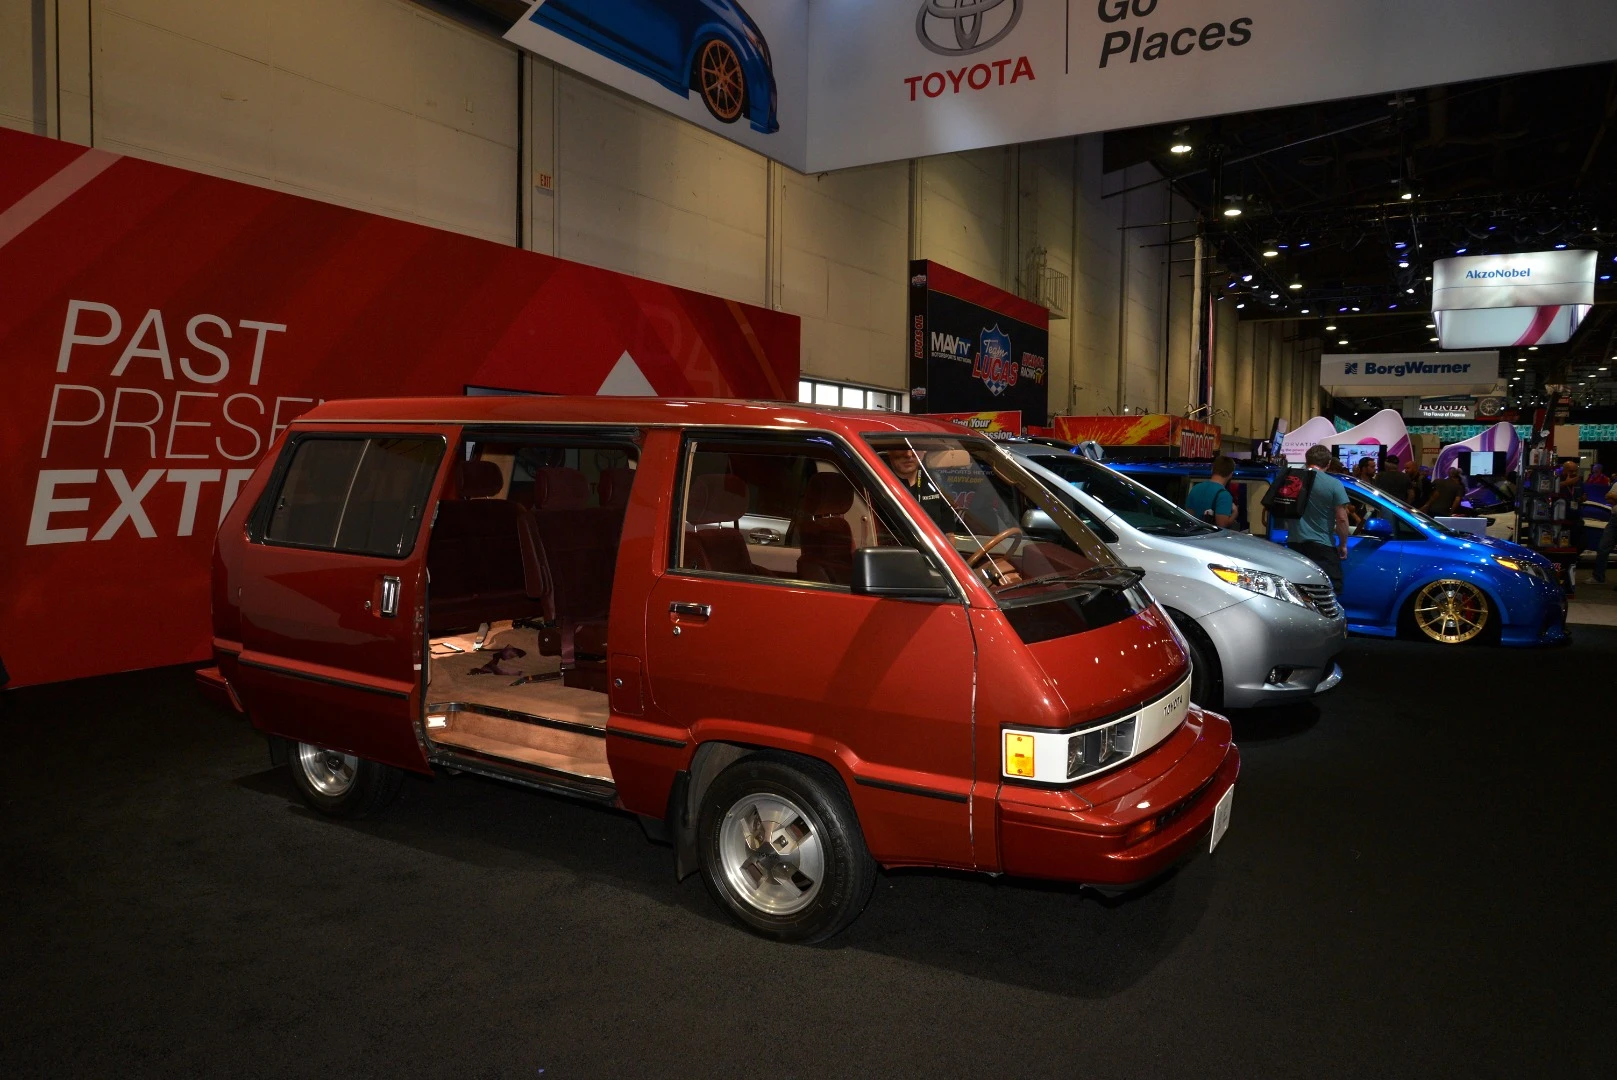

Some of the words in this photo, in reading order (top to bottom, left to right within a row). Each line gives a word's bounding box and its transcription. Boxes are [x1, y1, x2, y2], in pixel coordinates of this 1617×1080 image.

[1097, 0, 1157, 23] Go
[1098, 17, 1253, 69] Places
[904, 56, 1036, 101] TOYOTA
[540, 174, 552, 188] EXIT
[1465, 268, 1531, 279] AkzoNobel
[56, 299, 287, 386] PAST
[972, 352, 1018, 387] LUCAS
[1365, 361, 1471, 377] BorgWarner
[41, 384, 326, 461] PRESE
[970, 418, 991, 428] Your
[1163, 694, 1183, 717] TOYOTA
